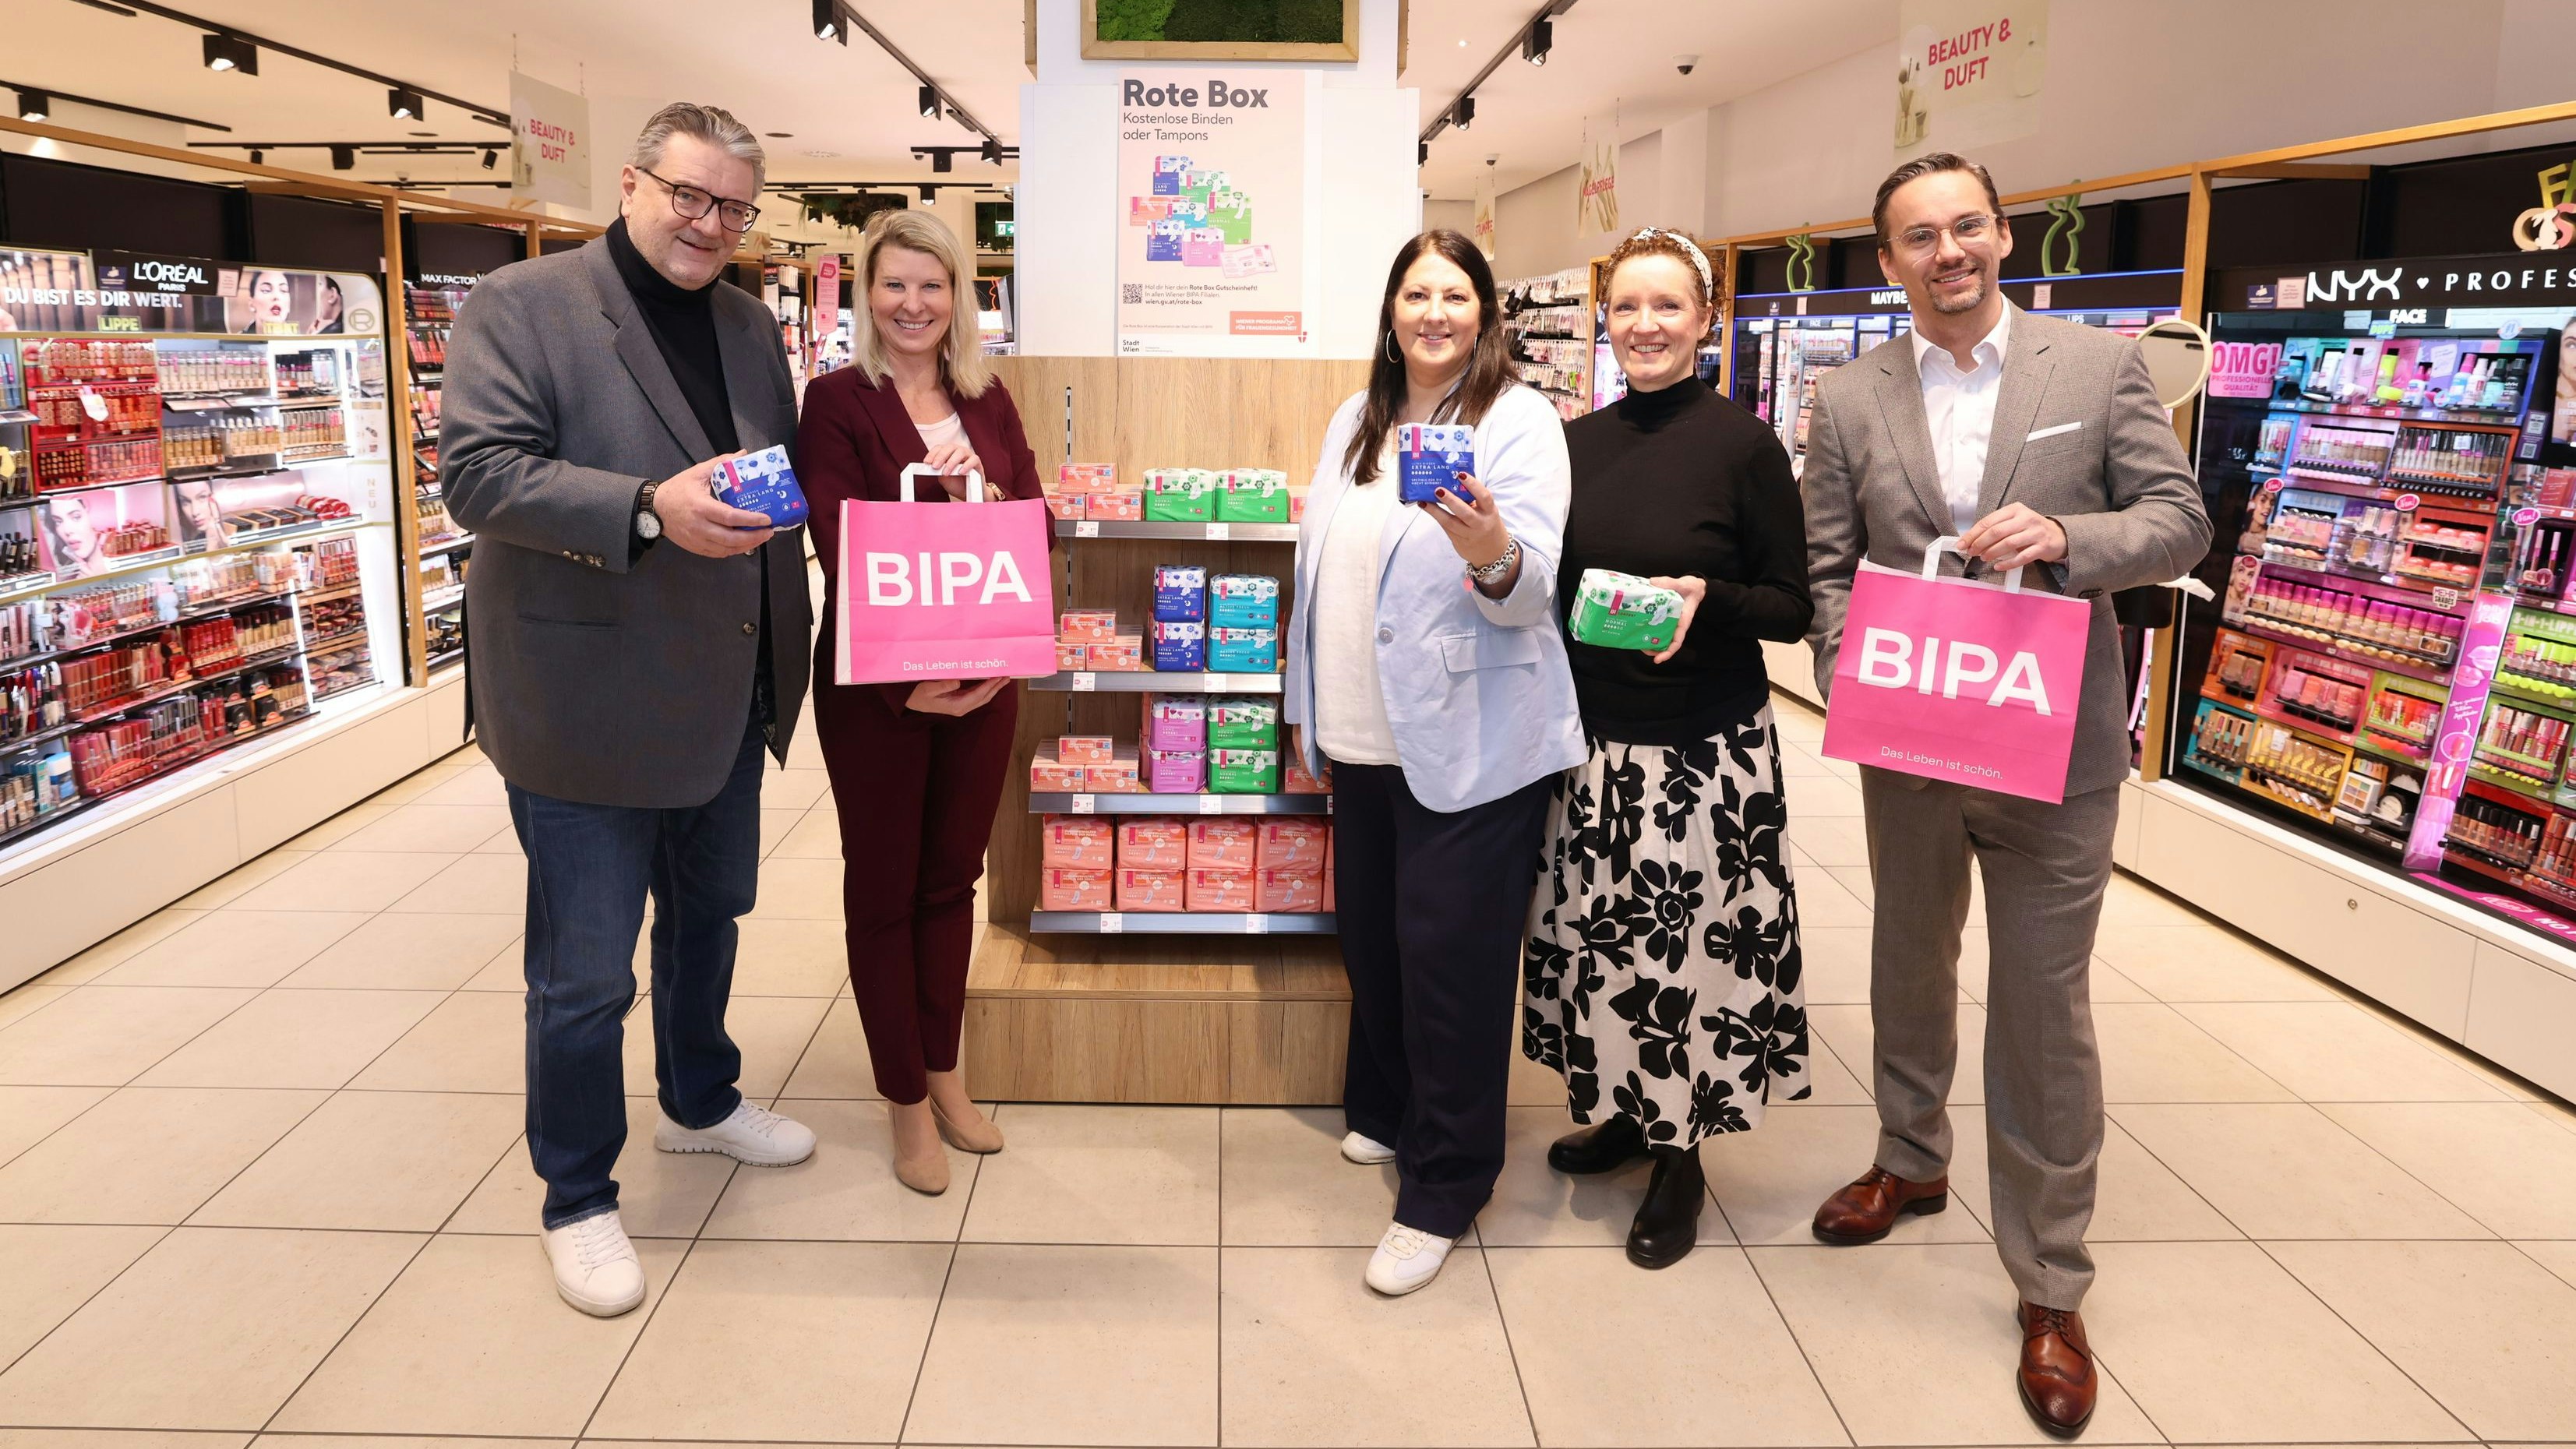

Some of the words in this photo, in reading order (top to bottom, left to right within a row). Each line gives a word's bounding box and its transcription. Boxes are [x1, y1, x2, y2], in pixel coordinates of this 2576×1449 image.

[1928, 23, 1996, 66] BEAUTY
[1999, 18, 2012, 42] &
[1944, 56, 1989, 90] DUFT
[1124, 79, 1198, 107] Rote
[1209, 80, 1269, 108] Box
[1123, 112, 1188, 125] Kostenlose
[1191, 113, 1233, 125] Binden
[530, 118, 567, 144] BEAUTY
[568, 131, 575, 146] &
[1123, 129, 1151, 140] oder
[1154, 129, 1209, 143] Tampons
[542, 143, 566, 164] DUFT
[134, 261, 209, 284] L'ORÉAL
[421, 273, 442, 283] MAX
[443, 275, 478, 286] FACTOR
[158, 282, 186, 291] PARIS
[2306, 267, 2402, 302] NYX
[5, 288, 29, 305] DU
[33, 289, 69, 305] BIST
[74, 290, 97, 306] ES
[101, 291, 131, 307] DIR
[133, 292, 183, 308] WERT.
[100, 317, 139, 331] LIPPE
[2067, 314, 2085, 323] LIPS
[2389, 308, 2427, 324] FACE
[2211, 345, 2278, 375] OMG!
[736, 494, 756, 503] EXTRA
[758, 488, 774, 496] LANG
[866, 551, 1033, 606] BIPA
[903, 661, 923, 671] Das
[926, 660, 958, 671] Leben
[960, 660, 972, 669] ist
[975, 658, 1008, 668] schön.
[1857, 626, 2052, 717] BIPA
[1881, 746, 1904, 760] Das
[1906, 750, 1943, 767] Leben
[1946, 758, 1961, 770] ist
[1963, 761, 2004, 779] schön.
[2534, 917, 2571, 930] NO
